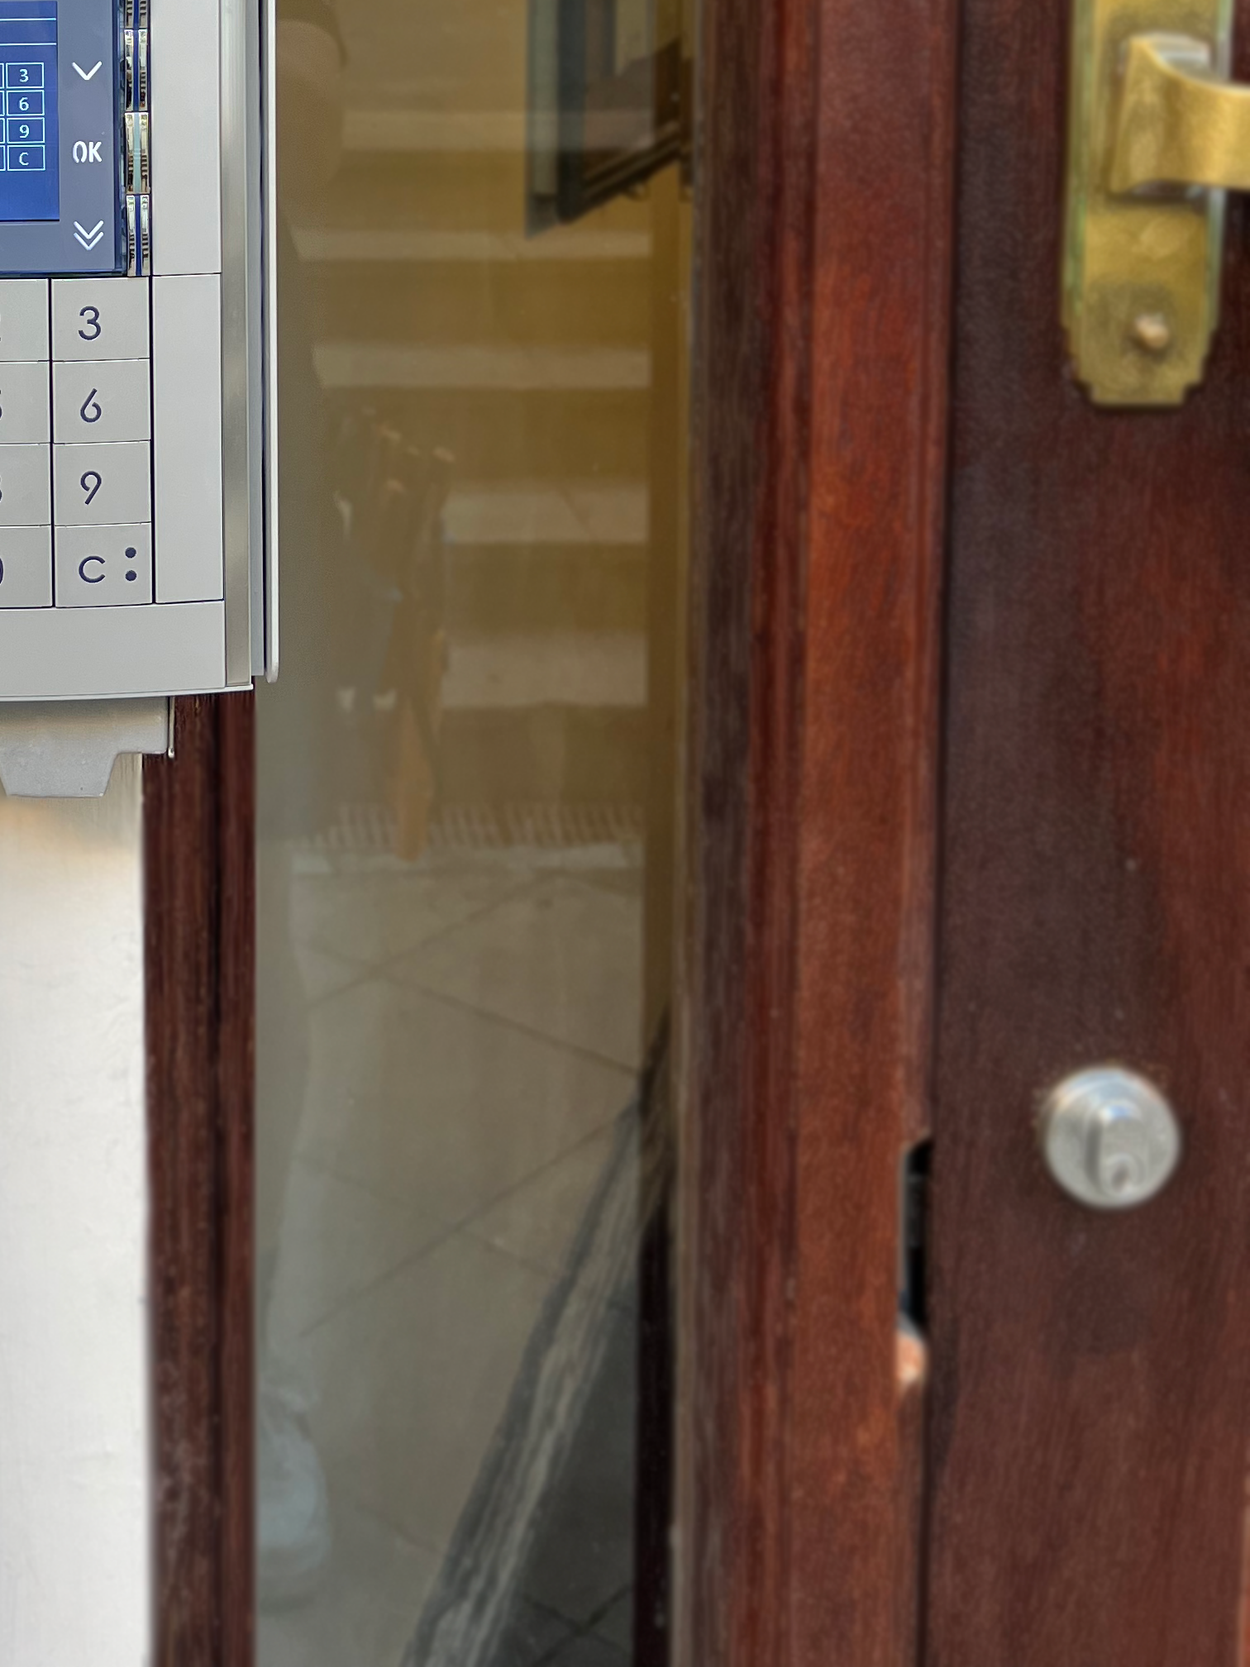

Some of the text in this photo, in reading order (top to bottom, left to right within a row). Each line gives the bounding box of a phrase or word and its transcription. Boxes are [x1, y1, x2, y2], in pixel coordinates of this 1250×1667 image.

[19, 68, 29, 83] 3
[19, 97, 30, 111] 6
[19, 124, 30, 139] 9
[18, 152, 29, 166] C
[72, 140, 103, 164] OK
[78, 306, 102, 341] 3
[80, 388, 102, 423] 6
[80, 471, 102, 506] 9
[78, 555, 106, 584] C
